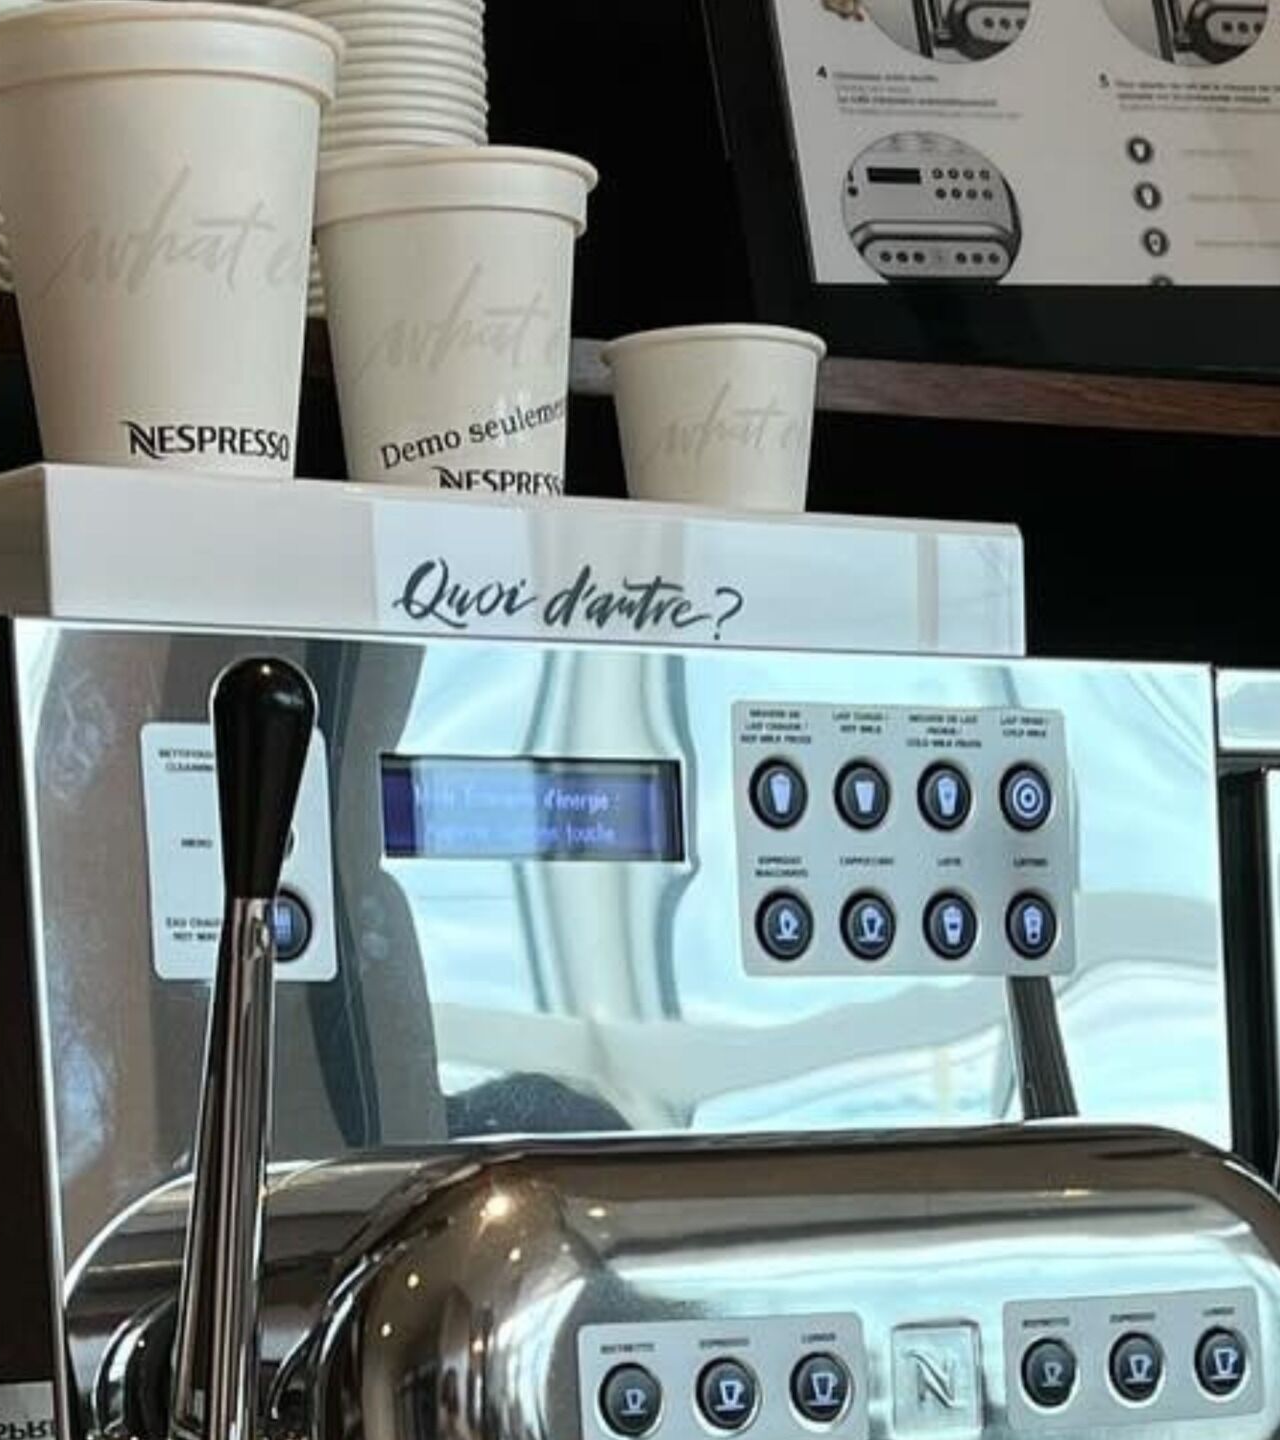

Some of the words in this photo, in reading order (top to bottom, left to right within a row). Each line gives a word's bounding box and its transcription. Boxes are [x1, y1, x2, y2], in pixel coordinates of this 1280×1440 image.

[816, 65, 828, 79] 4
[120, 421, 289, 462] NESPRESSO
[380, 429, 461, 469] Demo
[393, 557, 536, 630] Quoi
